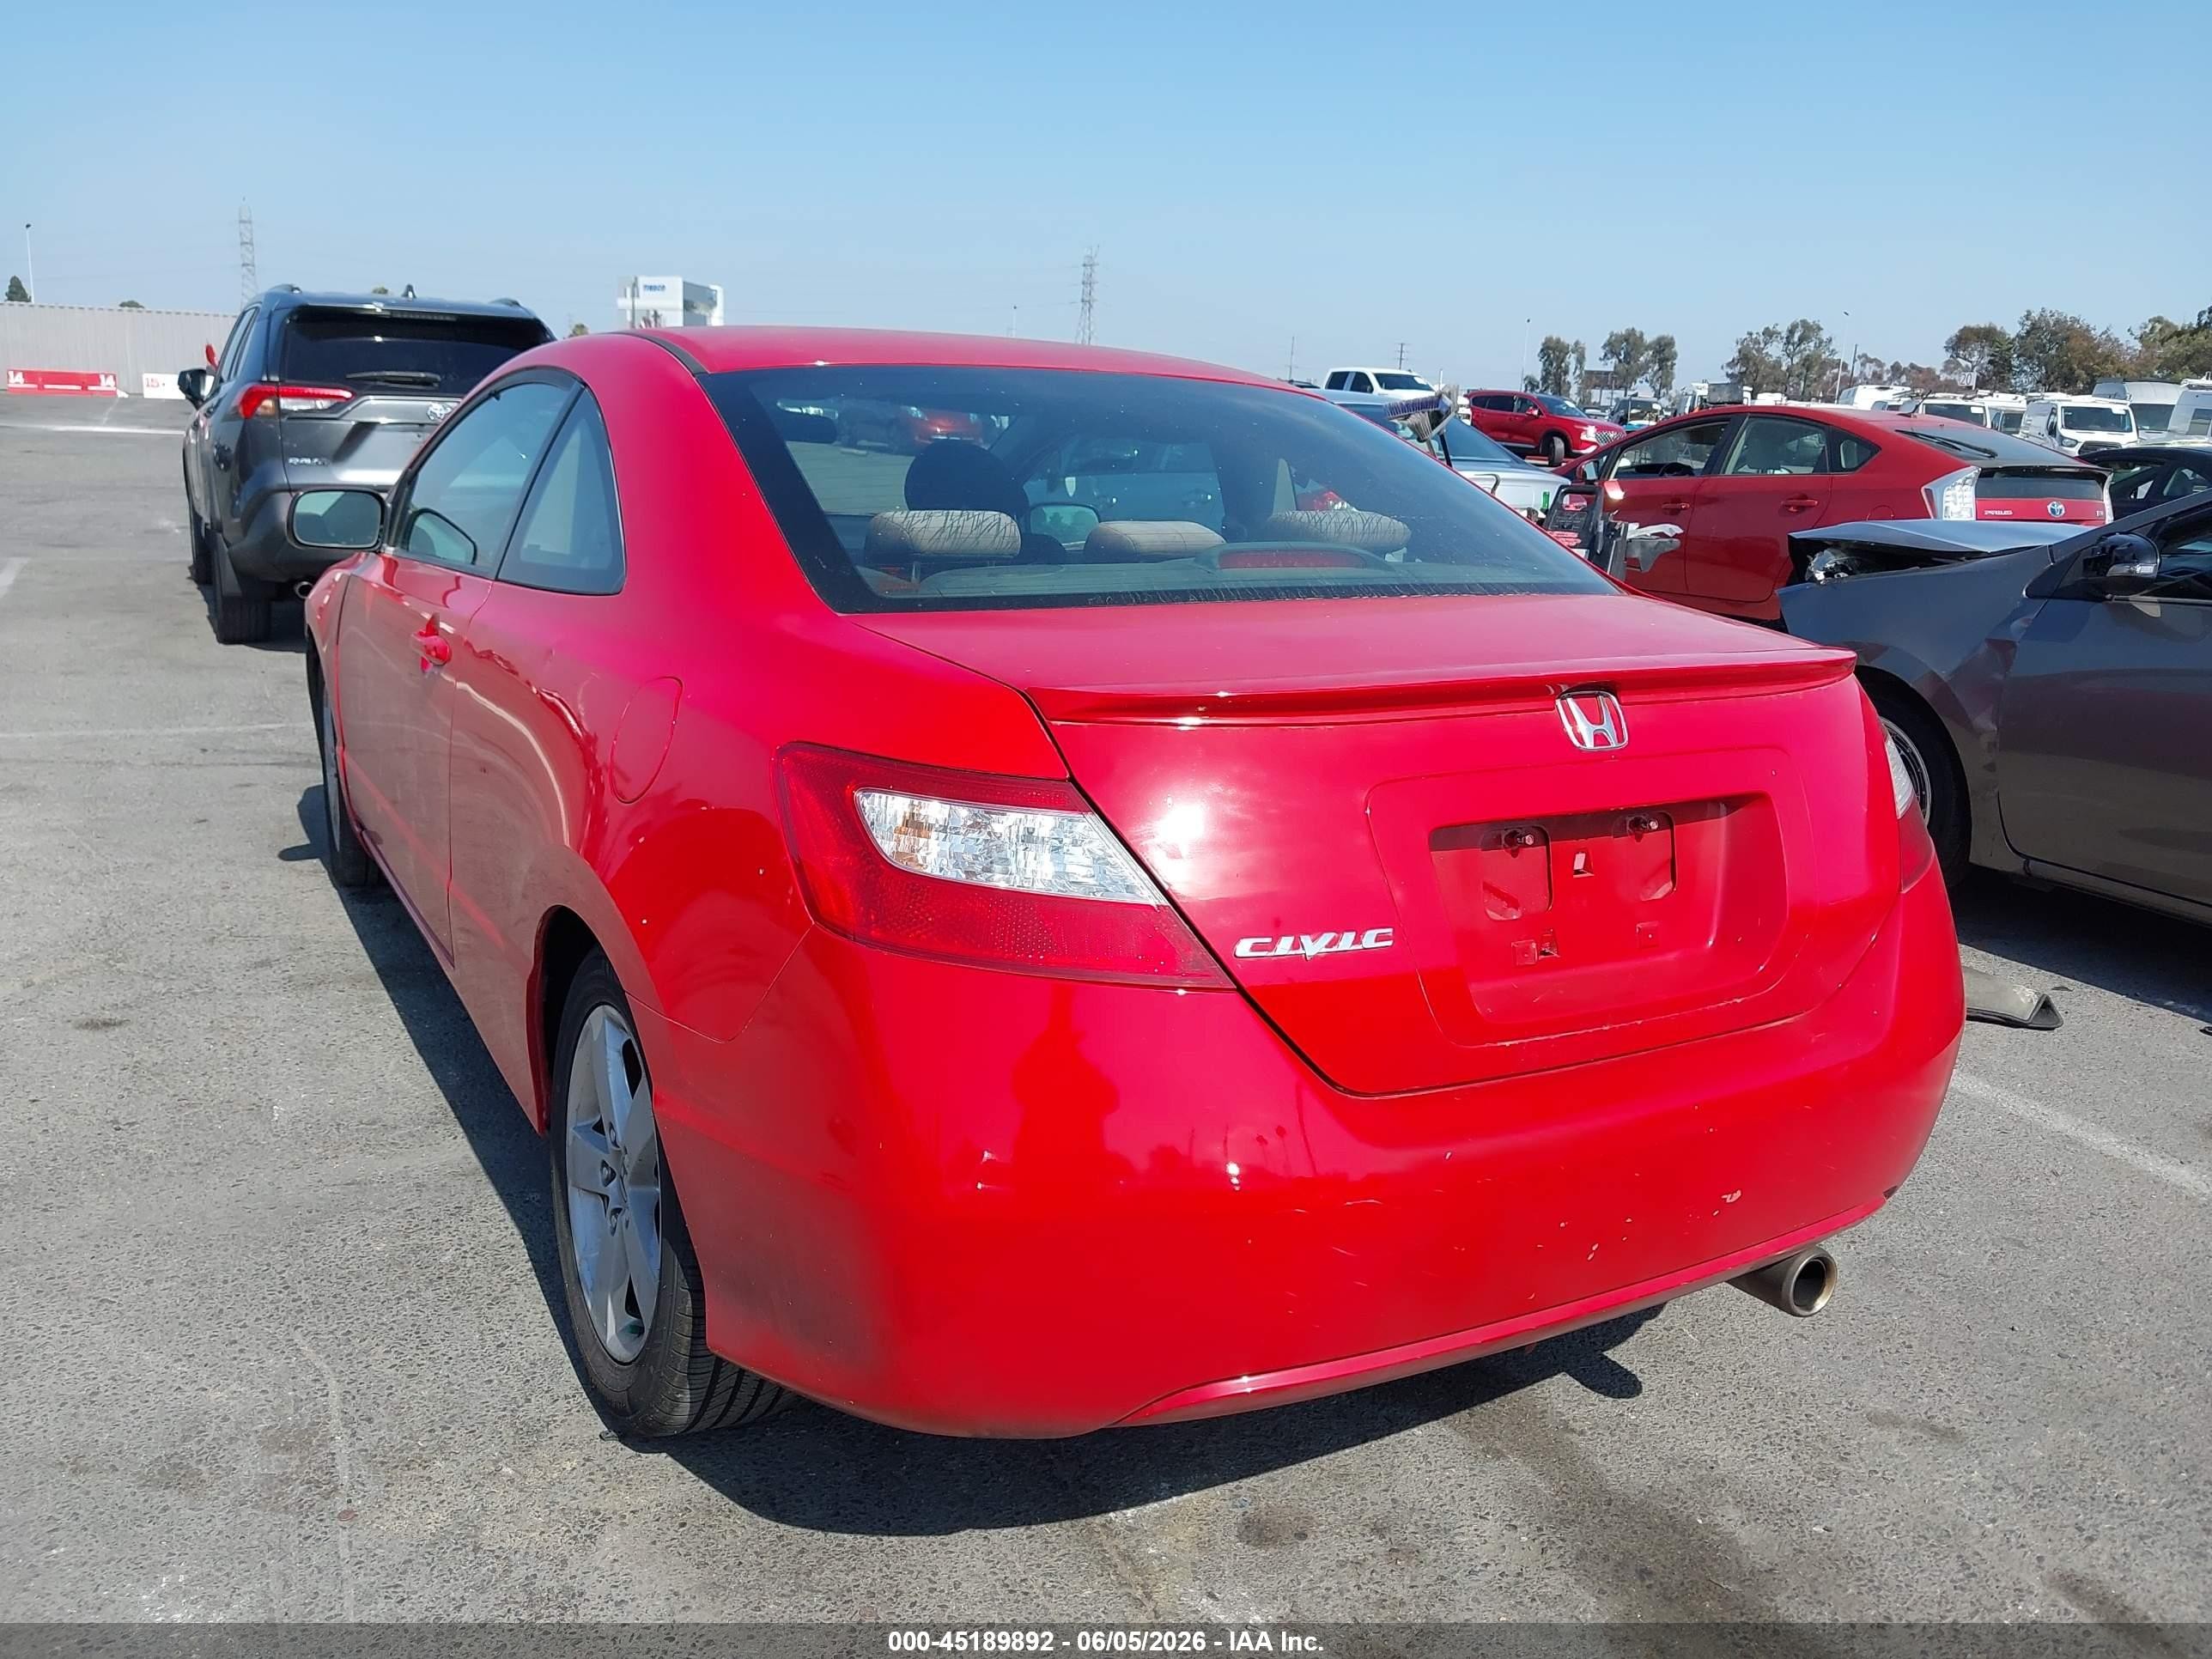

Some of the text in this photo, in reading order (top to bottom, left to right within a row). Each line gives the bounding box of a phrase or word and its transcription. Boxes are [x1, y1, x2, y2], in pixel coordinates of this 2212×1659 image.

[8, 371, 24, 385] 14
[100, 374, 116, 386] 14
[1960, 373, 1972, 386] 20
[1234, 927, 1395, 960] CIVIC
